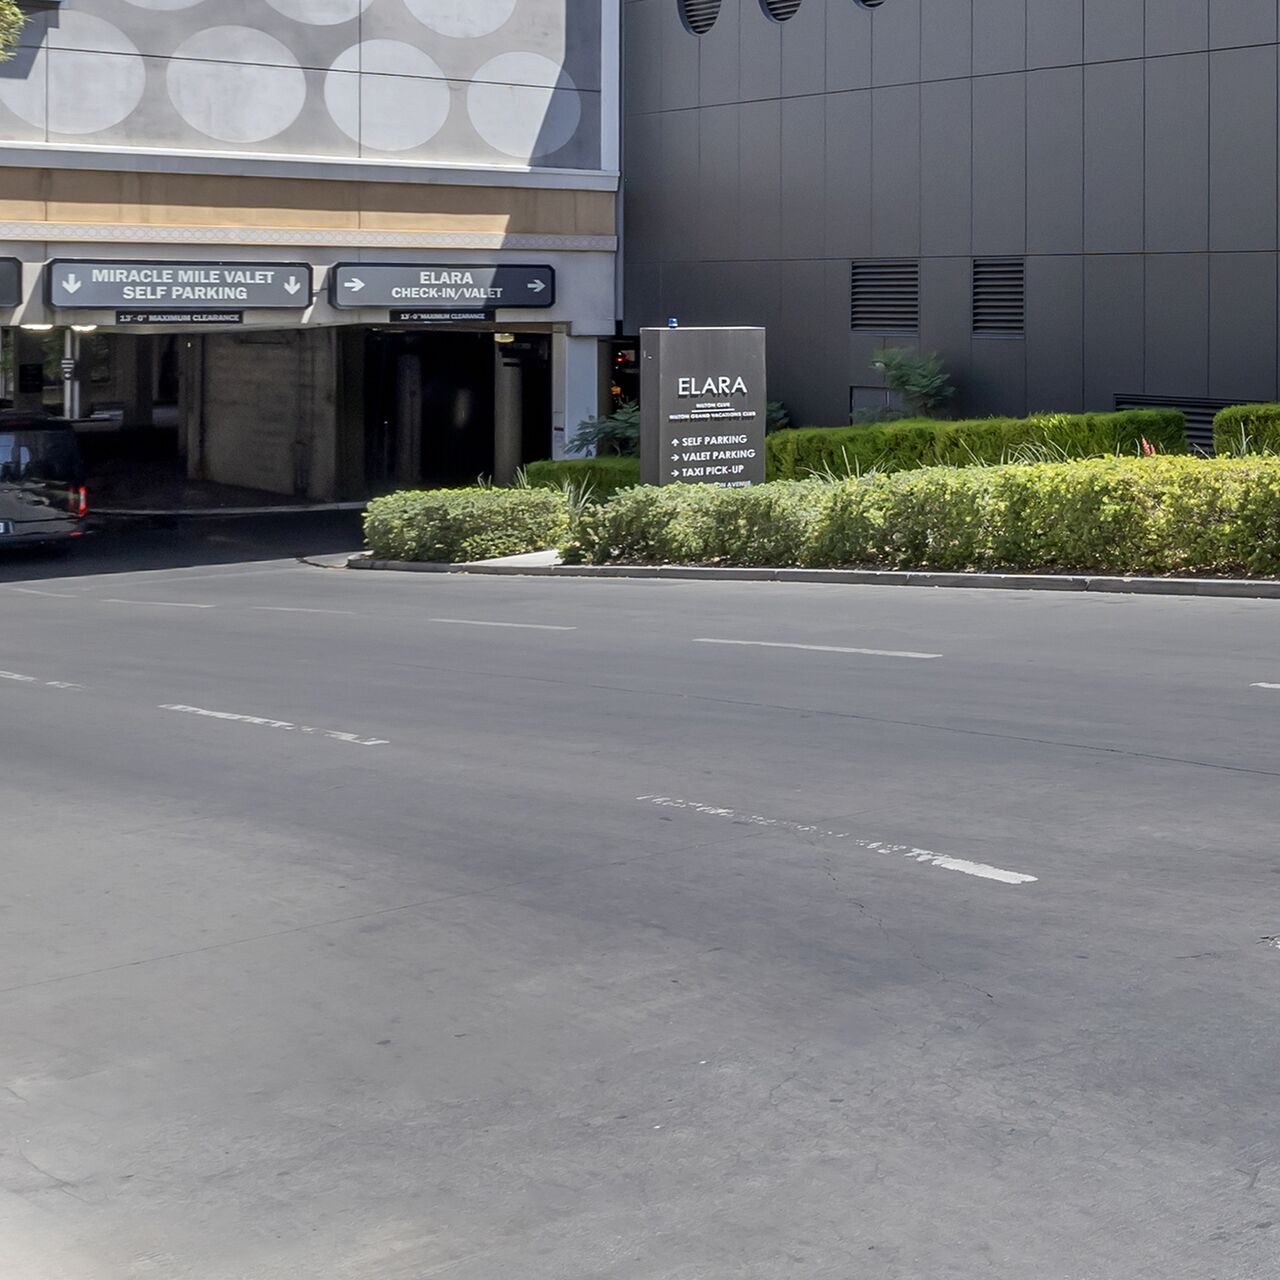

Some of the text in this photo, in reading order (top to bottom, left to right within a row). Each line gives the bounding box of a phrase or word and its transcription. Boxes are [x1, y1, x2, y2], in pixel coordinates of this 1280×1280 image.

[92, 270, 274, 283] MIRACLE MILE VALET
[420, 272, 473, 284] ELARA
[123, 286, 247, 299] SELF PARKING
[392, 288, 502, 300] CHECK-IN/VALET
[679, 377, 747, 394] ELARA
[682, 435, 747, 446] SELF PARKING
[682, 449, 755, 461] VALET PARKING
[682, 465, 744, 477] TAXI PICK-UP
